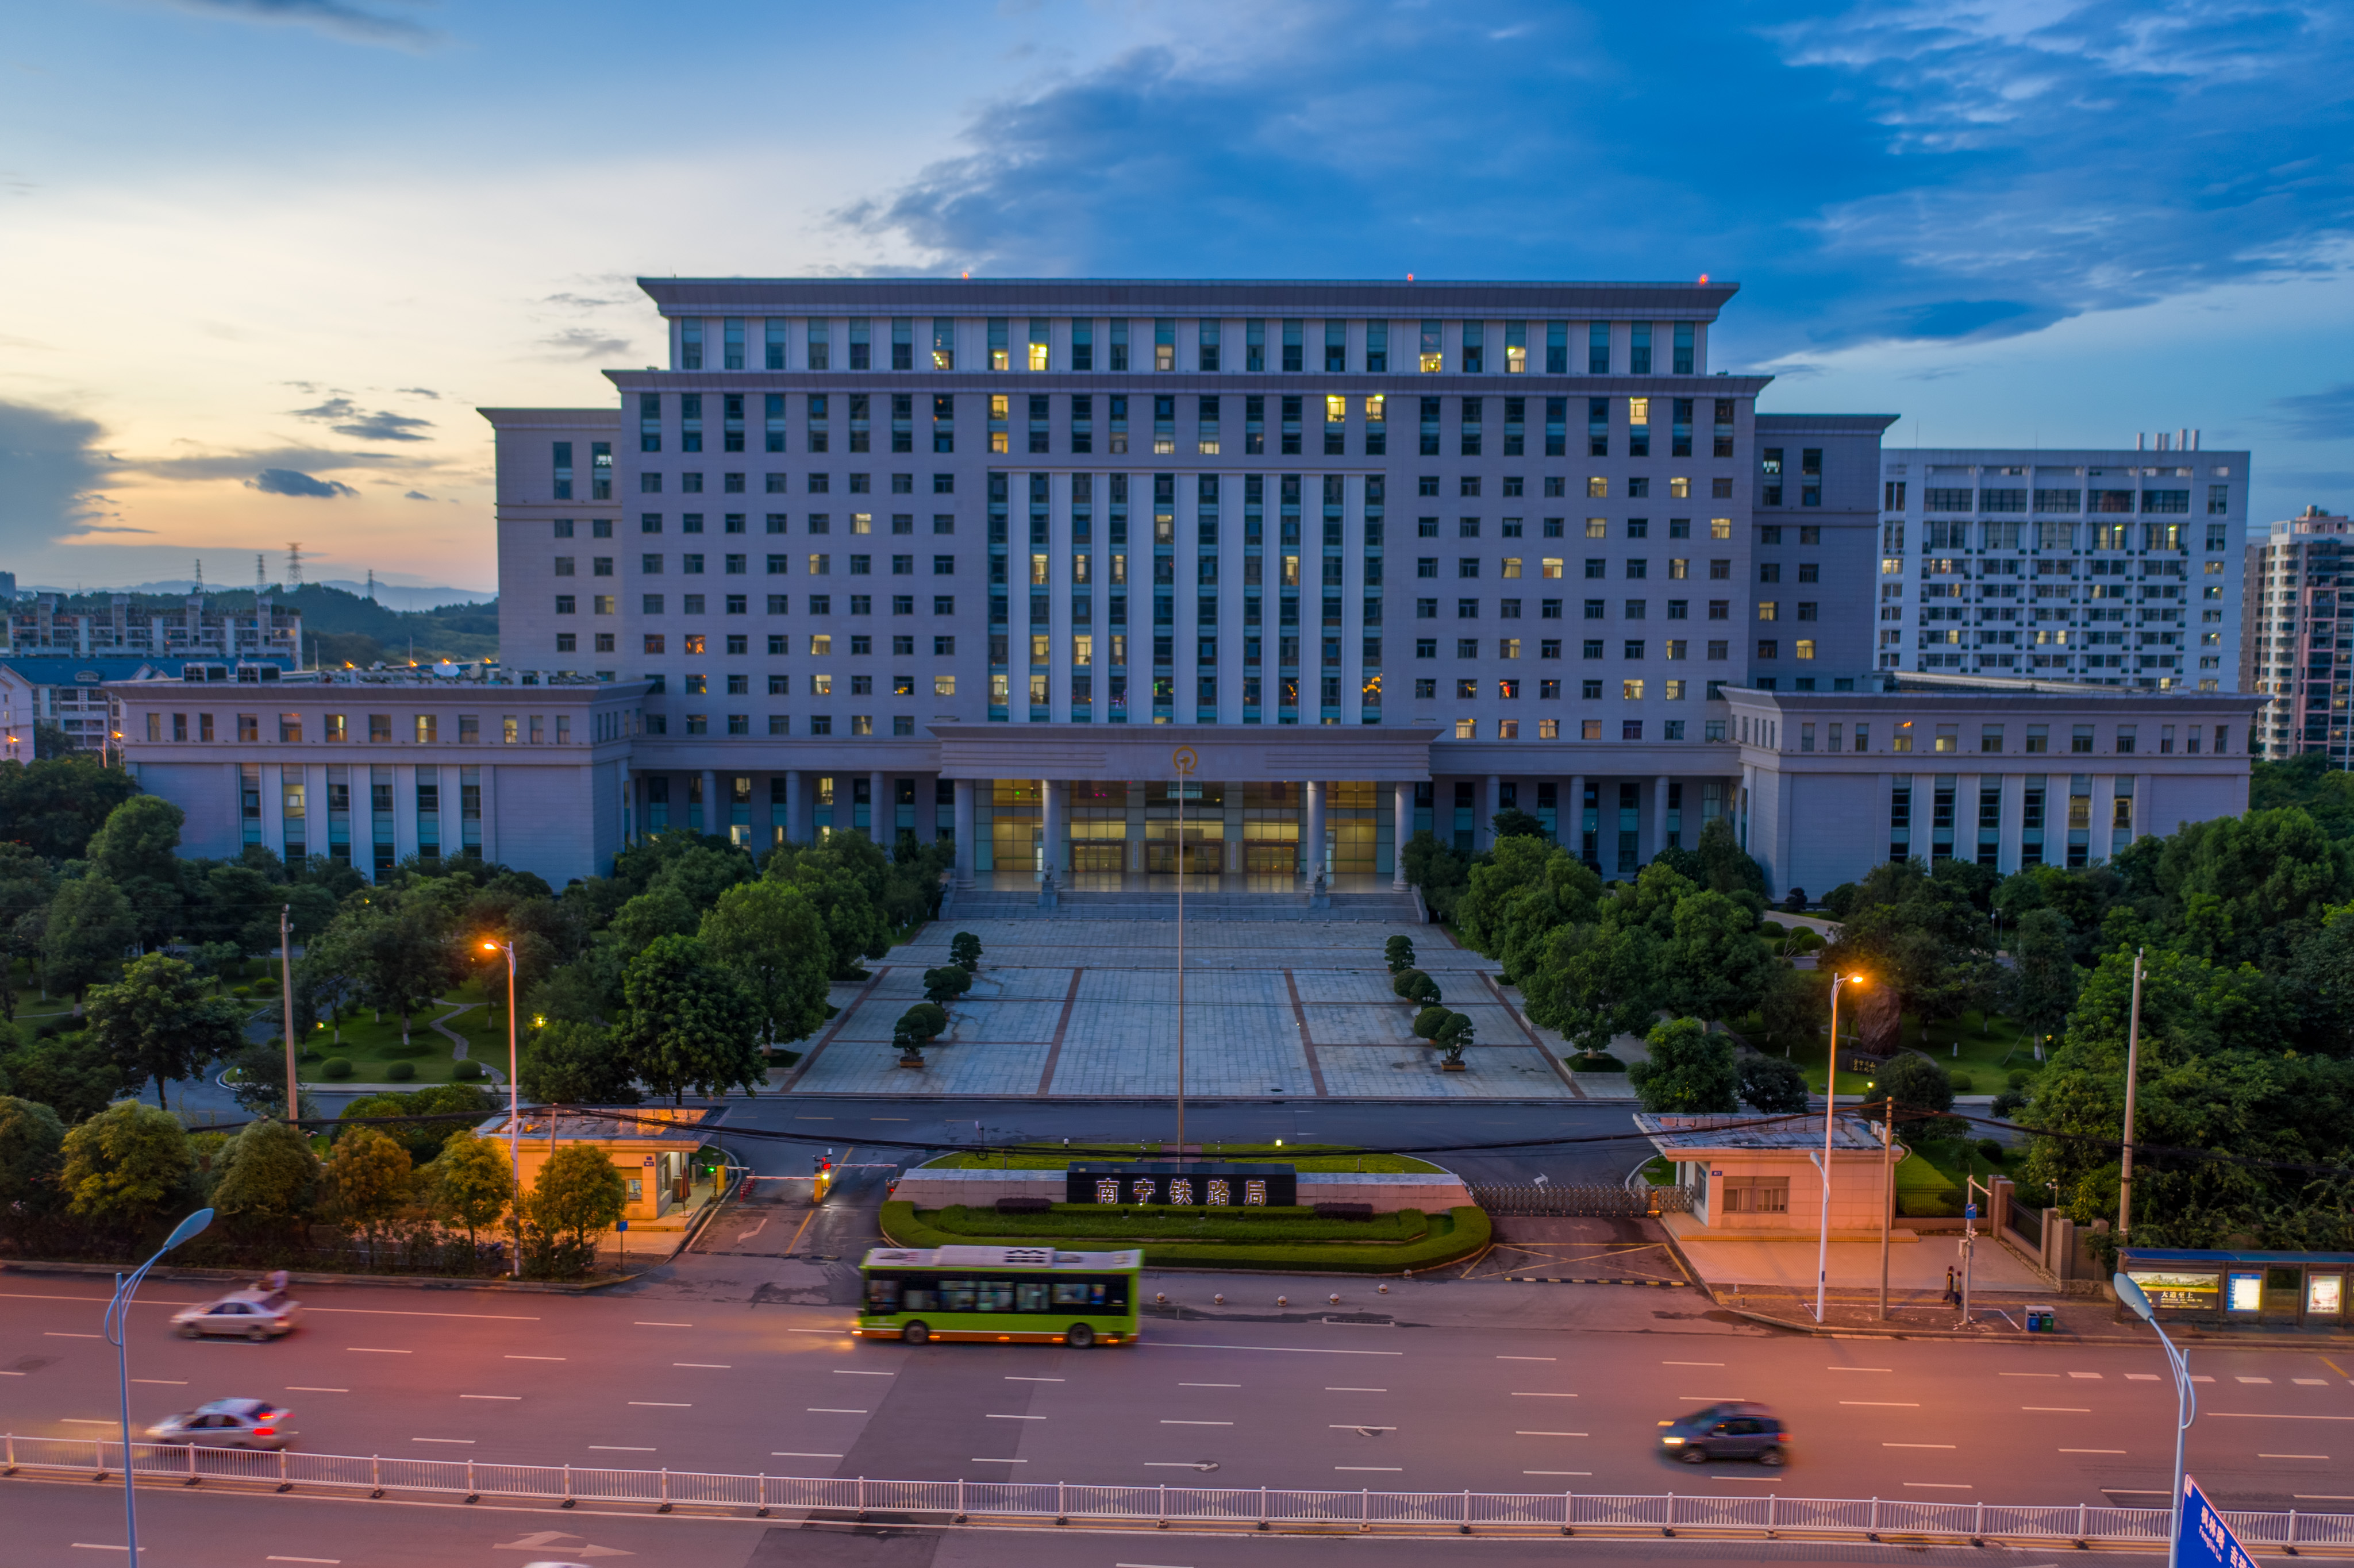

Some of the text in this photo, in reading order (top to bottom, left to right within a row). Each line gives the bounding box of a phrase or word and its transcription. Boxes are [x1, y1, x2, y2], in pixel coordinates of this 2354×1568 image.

[1096, 1178, 1267, 1206] 南宁铁路局
[2199, 1525, 2222, 1563] Fenglin Lu
[2201, 1505, 2225, 1550] 枫林路
